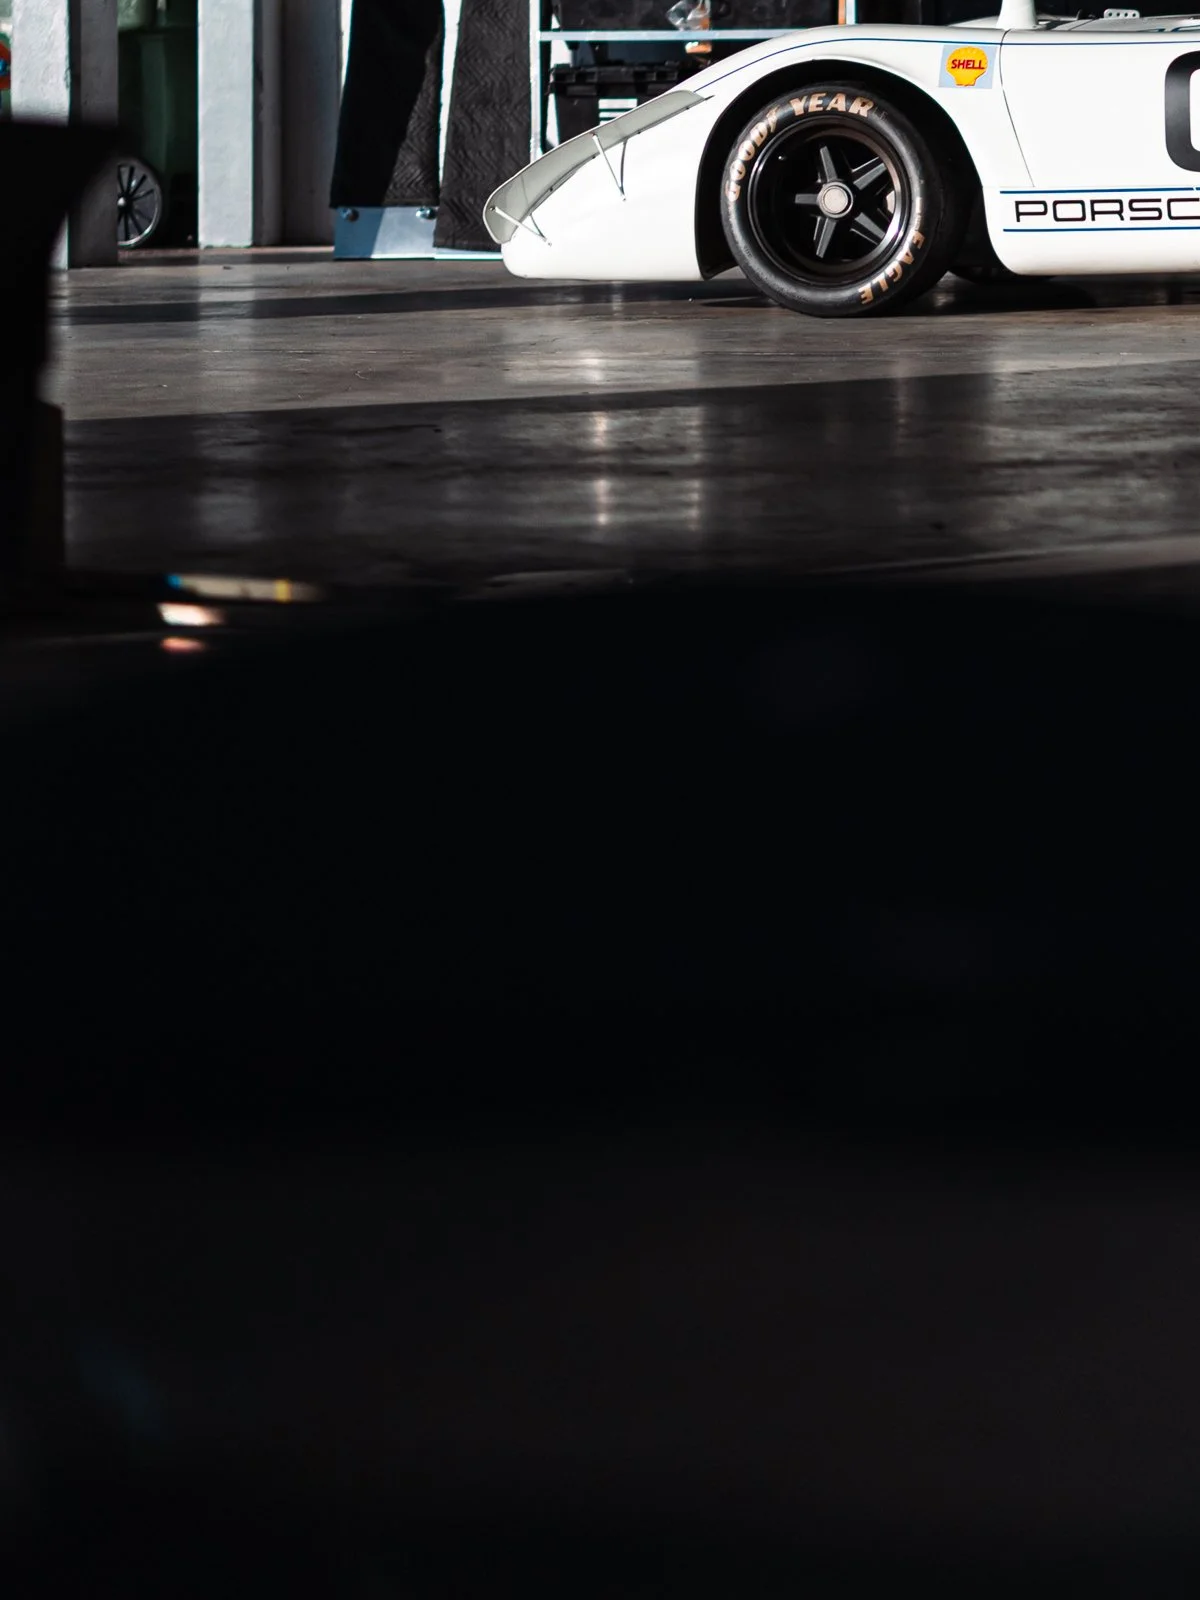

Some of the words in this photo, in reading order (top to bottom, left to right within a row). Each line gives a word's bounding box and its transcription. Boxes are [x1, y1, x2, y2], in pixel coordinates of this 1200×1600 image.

[951, 58, 986, 70] SHELL
[790, 92, 875, 118] YEAR
[858, 230, 926, 304] EAGLE
